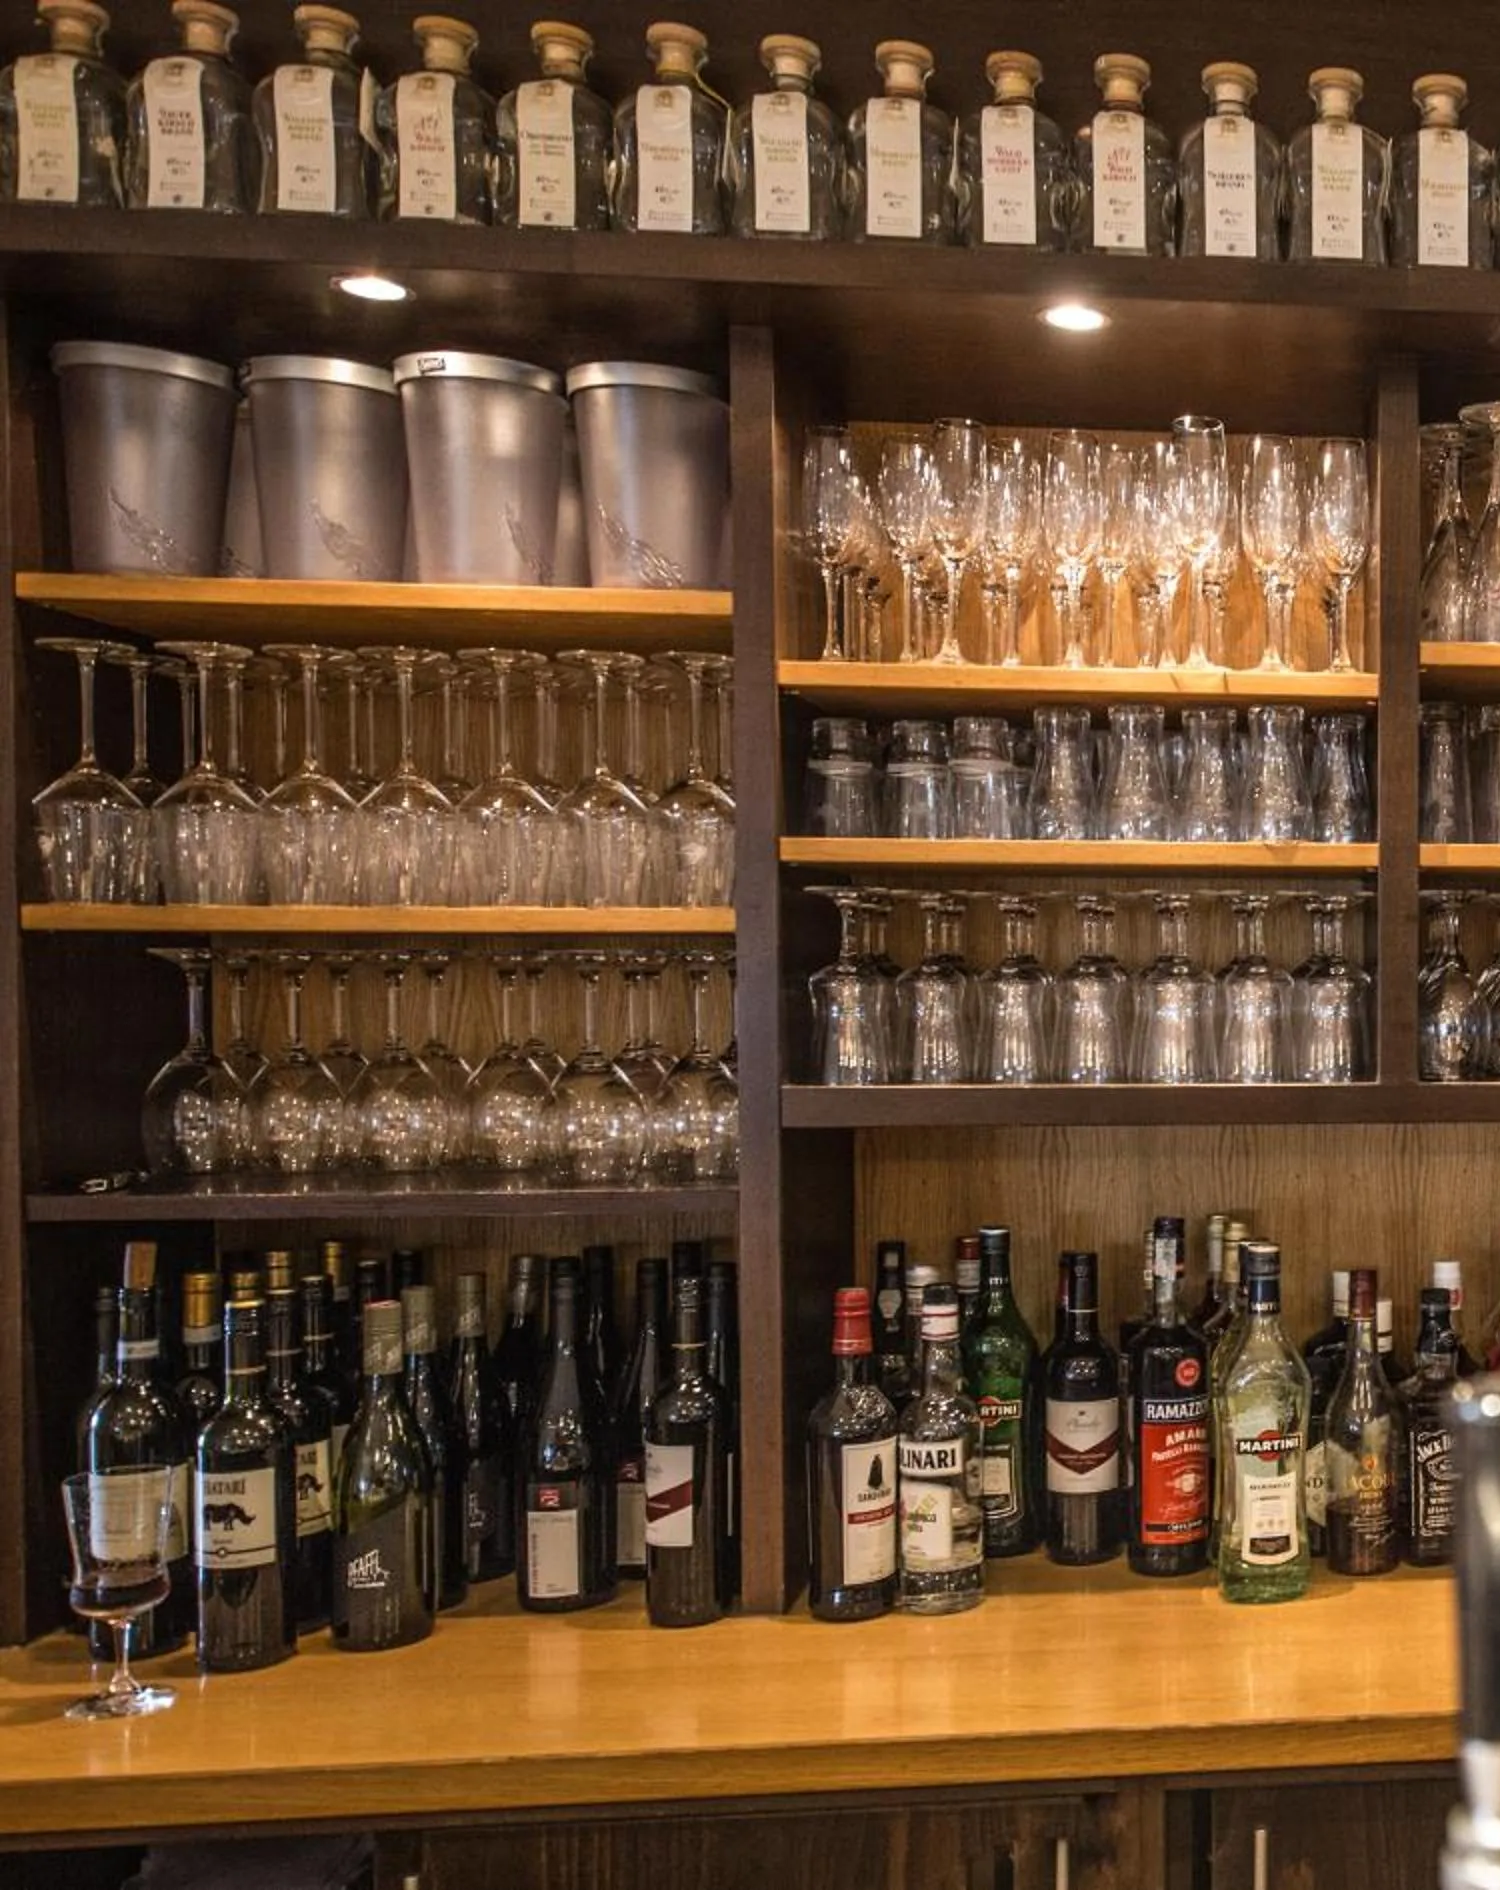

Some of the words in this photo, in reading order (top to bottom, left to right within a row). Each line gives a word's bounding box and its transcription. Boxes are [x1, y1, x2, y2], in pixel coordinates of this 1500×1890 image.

[979, 1405, 1018, 1418] RTINI
[1239, 1435, 1299, 1454] MARTINI
[900, 1448, 956, 1470] LINARI
